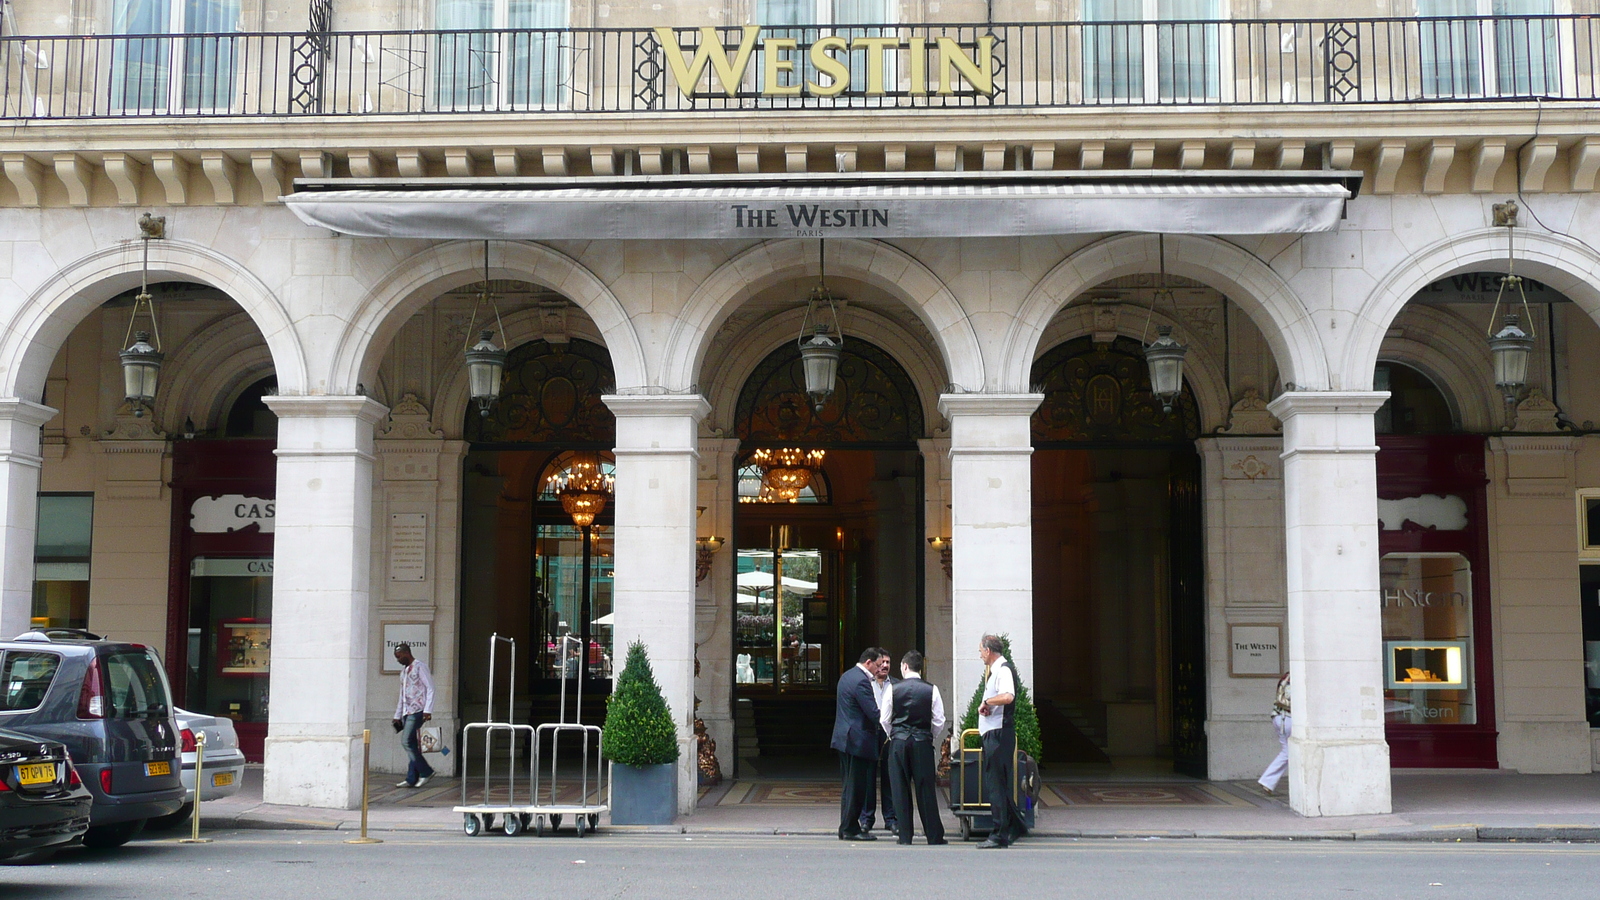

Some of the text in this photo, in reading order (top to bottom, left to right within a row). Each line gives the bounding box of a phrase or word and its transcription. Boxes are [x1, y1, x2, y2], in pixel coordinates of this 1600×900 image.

[653, 24, 994, 98] WESTIN
[731, 204, 889, 228] THE WESTIN
[796, 229, 824, 237] PARIS
[1235, 642, 1277, 650] THE WESTIN
[21, 767, 29, 779] 67
